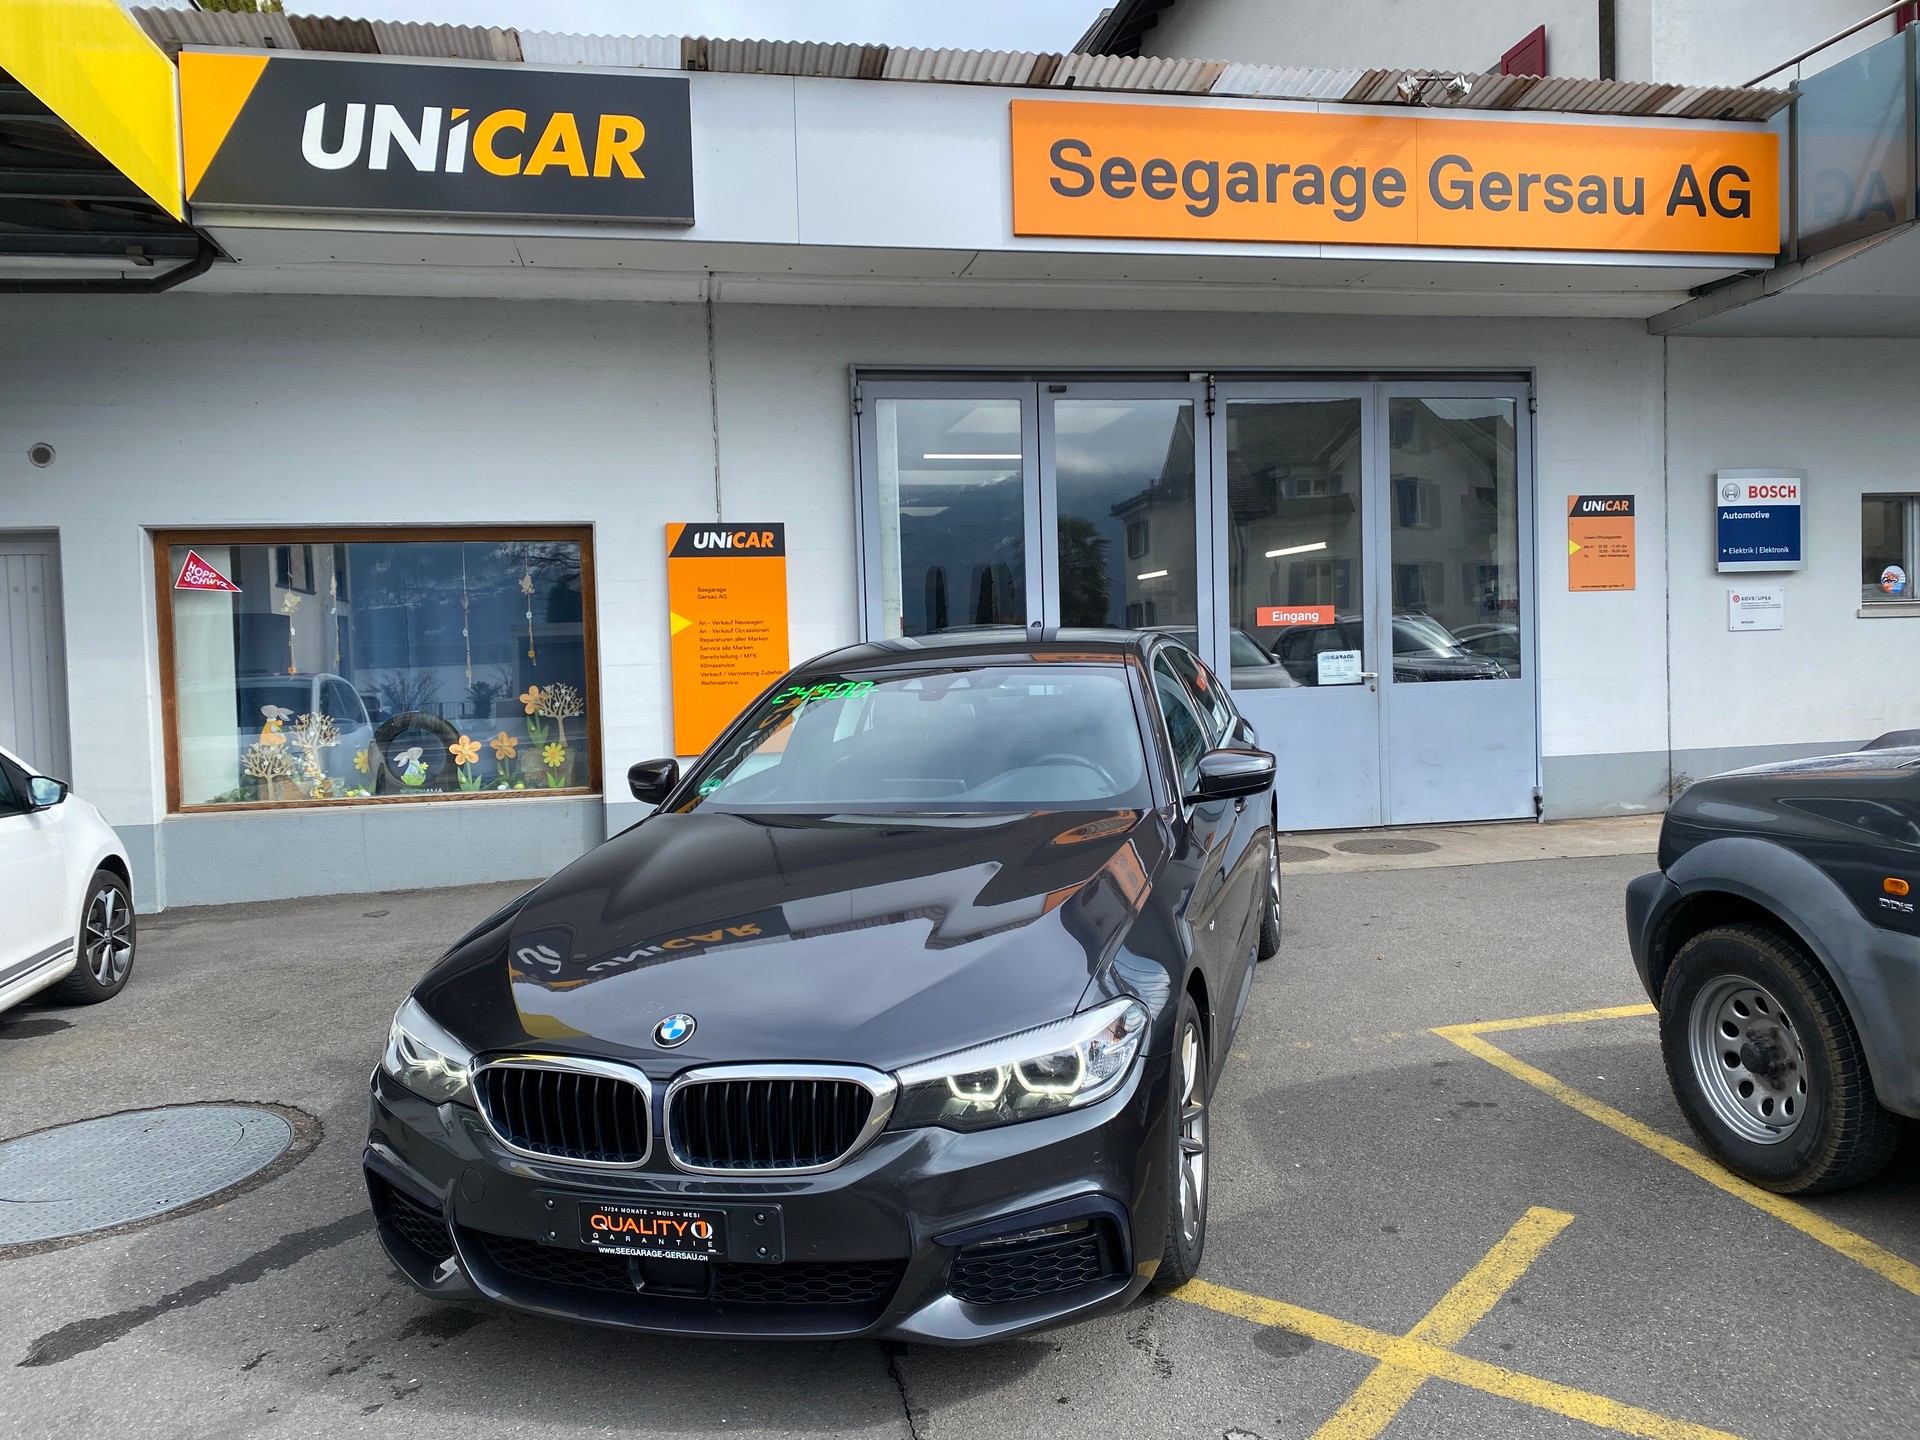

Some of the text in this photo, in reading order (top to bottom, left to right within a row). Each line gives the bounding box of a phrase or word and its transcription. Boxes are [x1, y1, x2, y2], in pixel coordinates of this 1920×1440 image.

[1049, 138, 1751, 222] Seegarage Gersau AG
[1748, 485, 1797, 499] BOSCH
[1722, 511, 1770, 520] Automotive
[1759, 546, 1790, 554] Elektronik
[187, 560, 217, 579] HOPP
[183, 571, 229, 590] SCHWYZ
[1272, 611, 1319, 623] Eingang
[600, 1205, 619, 1213] 12/24
[621, 1207, 648, 1215] MONATE
[590, 1214, 689, 1237] QUALITY
[592, 1231, 714, 1249] GARANTIE
